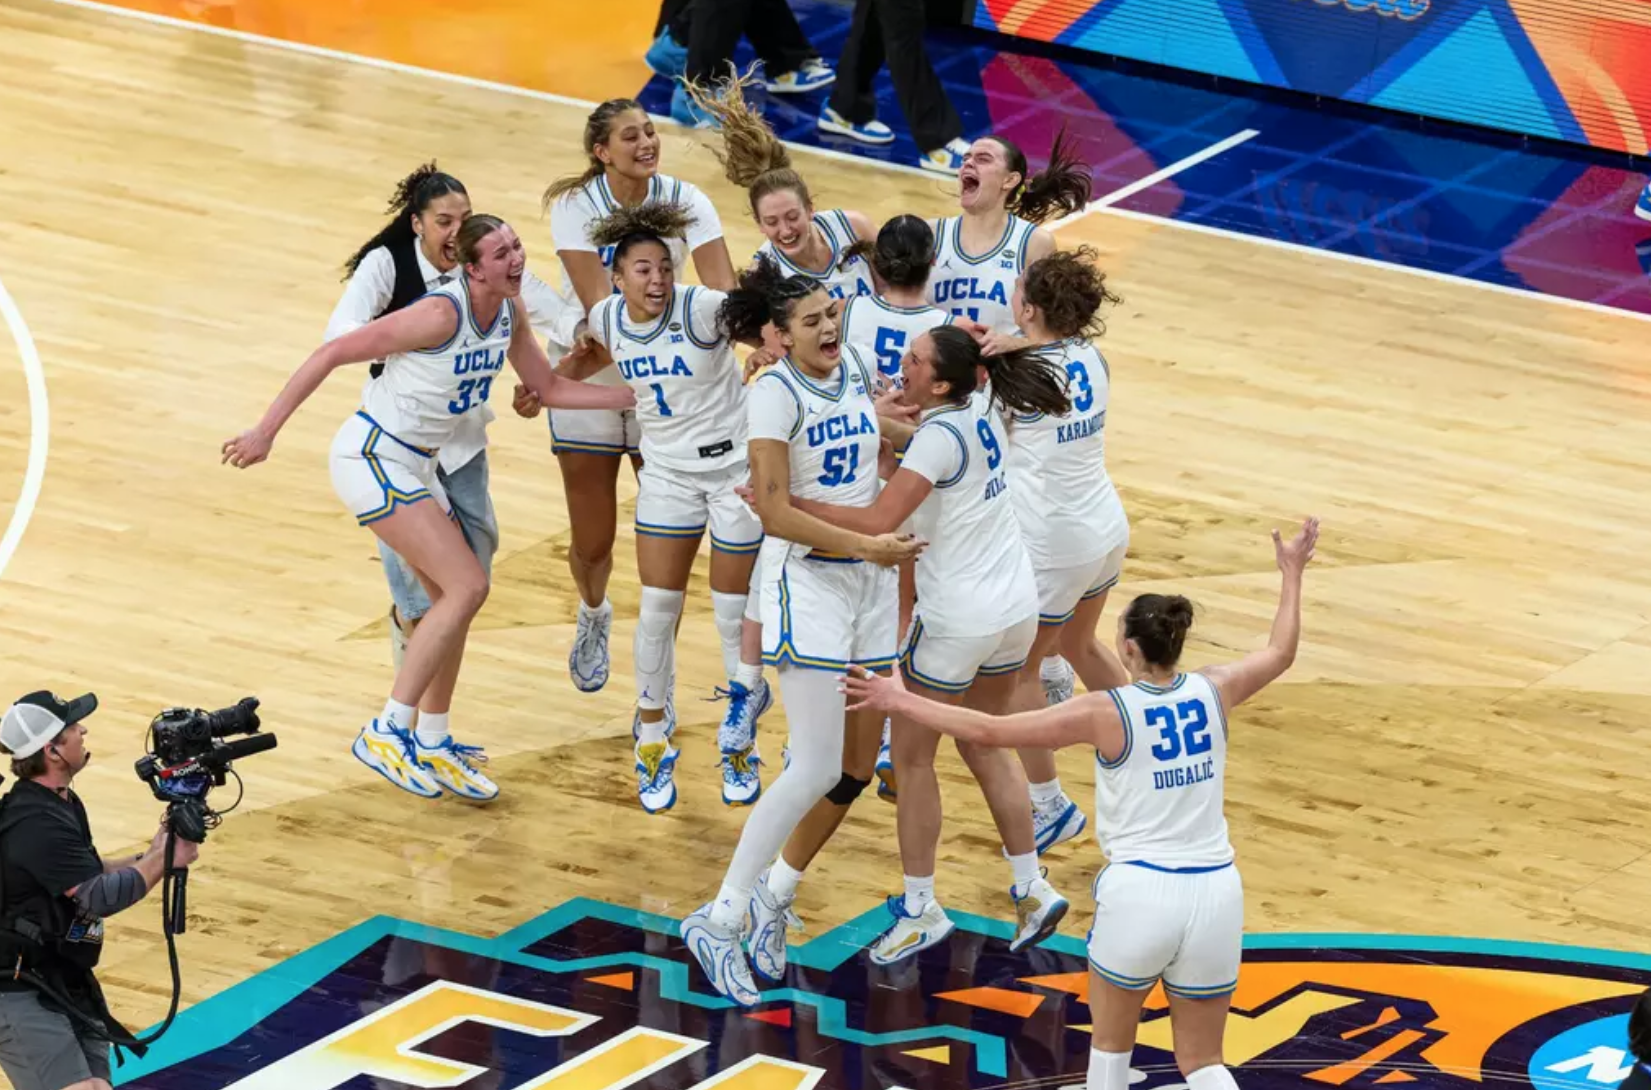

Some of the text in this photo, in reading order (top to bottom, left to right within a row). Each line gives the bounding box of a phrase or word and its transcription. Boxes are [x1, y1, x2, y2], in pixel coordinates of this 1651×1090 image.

[934, 277, 1007, 306] UCLA
[453, 349, 505, 375] UCLA
[617, 355, 693, 380] UCLA
[873, 326, 907, 376] 5
[448, 375, 493, 414] 33
[650, 383, 673, 417] 1
[1065, 360, 1094, 412] 3
[807, 412, 875, 448] UCLA
[976, 417, 1003, 471] 9
[817, 443, 860, 487] 51
[1143, 698, 1212, 762] 32
